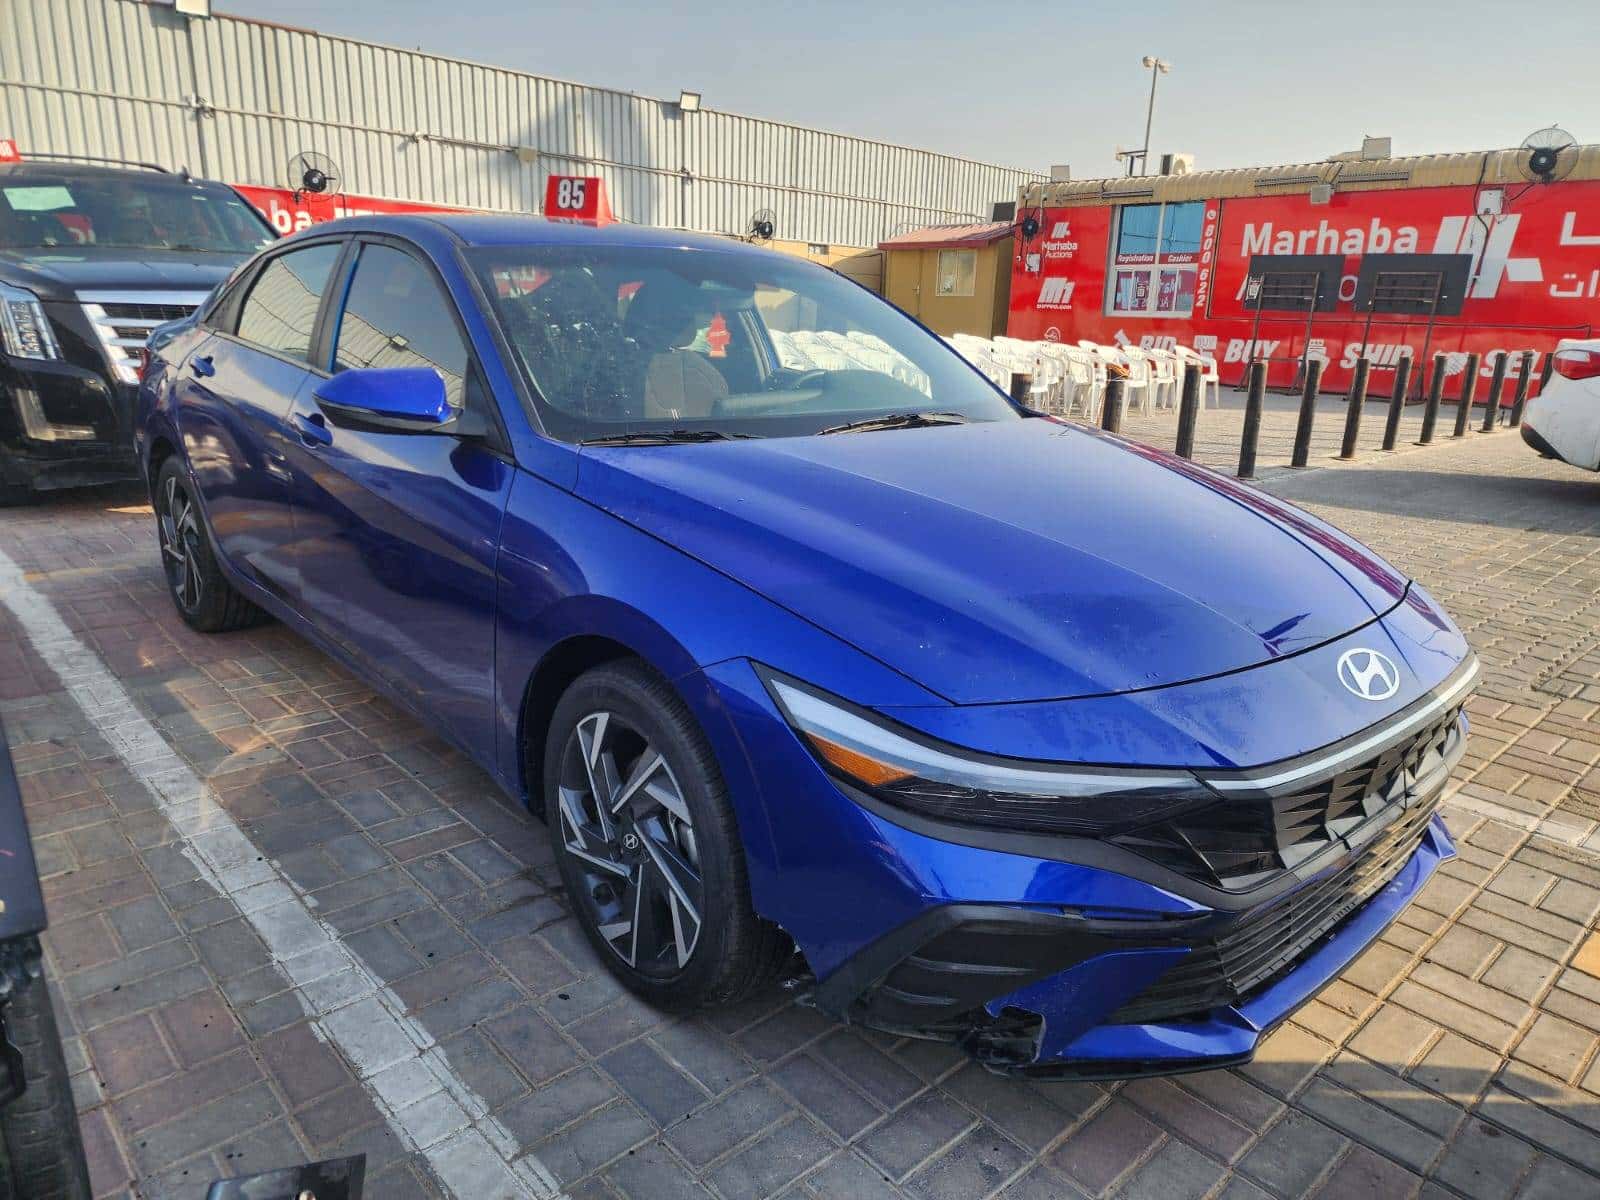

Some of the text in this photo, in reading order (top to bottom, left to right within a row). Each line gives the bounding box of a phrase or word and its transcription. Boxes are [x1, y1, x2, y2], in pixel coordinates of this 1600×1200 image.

[558, 180, 585, 209] 85
[1241, 217, 1419, 257] Marhaba
[1223, 338, 1280, 363] BUY
[1339, 342, 1414, 371] SHIP
[1480, 349, 1542, 379] SEL
